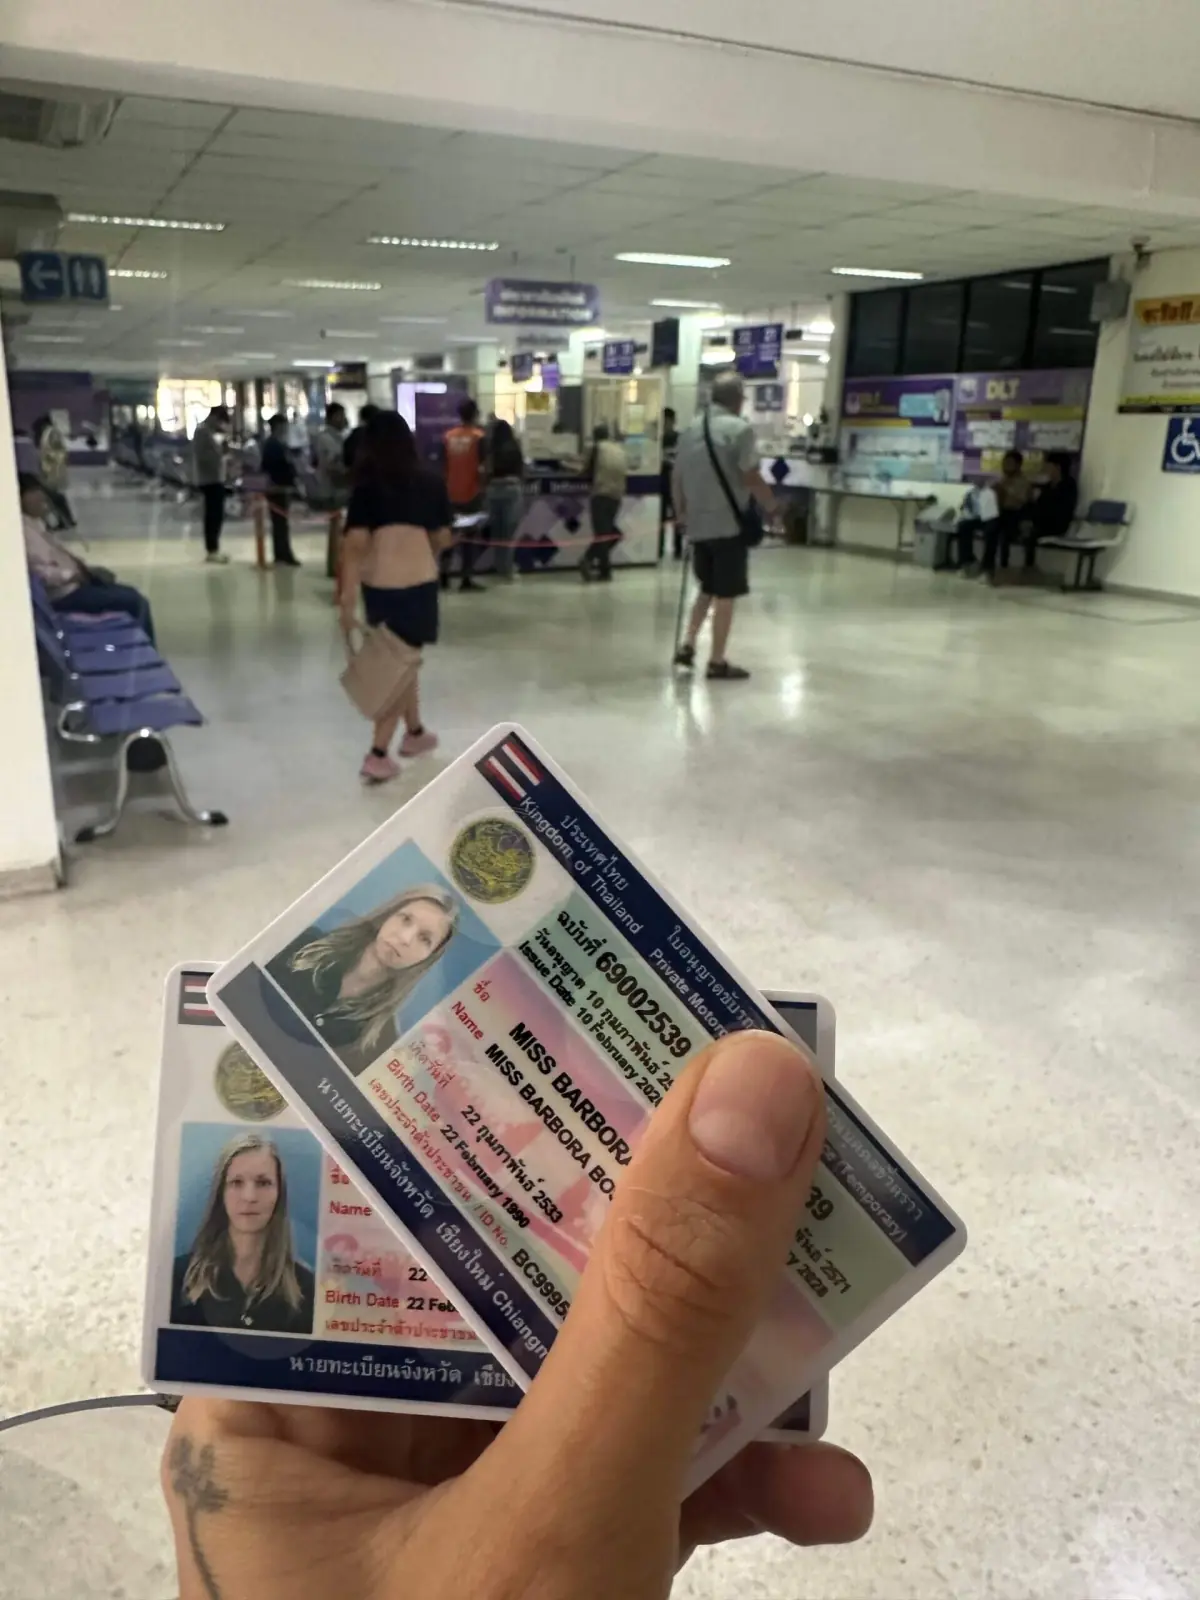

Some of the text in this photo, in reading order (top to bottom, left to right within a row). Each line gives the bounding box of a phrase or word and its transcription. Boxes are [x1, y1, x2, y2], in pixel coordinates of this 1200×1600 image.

[986, 378, 1019, 400] DLT
[519, 796, 643, 935] Kingdom of Thailand
[558, 814, 630, 892] ประเทศไทย
[556, 909, 606, 957] ฉบับที่
[592, 949, 693, 1060] 69002539
[584, 989, 605, 1010] 10
[648, 947, 691, 995] Private
[667, 924, 754, 1028] ใบอนุญาตขับรถ
[518, 940, 553, 977] Issue
[547, 974, 578, 1007] Date
[574, 1005, 594, 1025] 10
[588, 1022, 640, 1079] February
[508, 1022, 558, 1076] MISS
[451, 1001, 616, 1201] Name MISS BARBORA BO
[385, 1058, 531, 1229] Birth Date 22 February 1990
[460, 1104, 482, 1126] 22
[476, 1122, 544, 1192] กุมภาพันธ์
[531, 1189, 564, 1224] 2533
[316, 1076, 434, 1219] นายทะเบียนจังหวัด
[434, 1220, 503, 1291] เชียงใหม่
[330, 1200, 372, 1216] Name
[325, 1290, 459, 1313] Birth Date 22 Feb
[408, 1268, 428, 1281] 22
[510, 1248, 570, 1321] BC9995
[289, 1356, 462, 1384] นายทะเบียนจังหวัด
